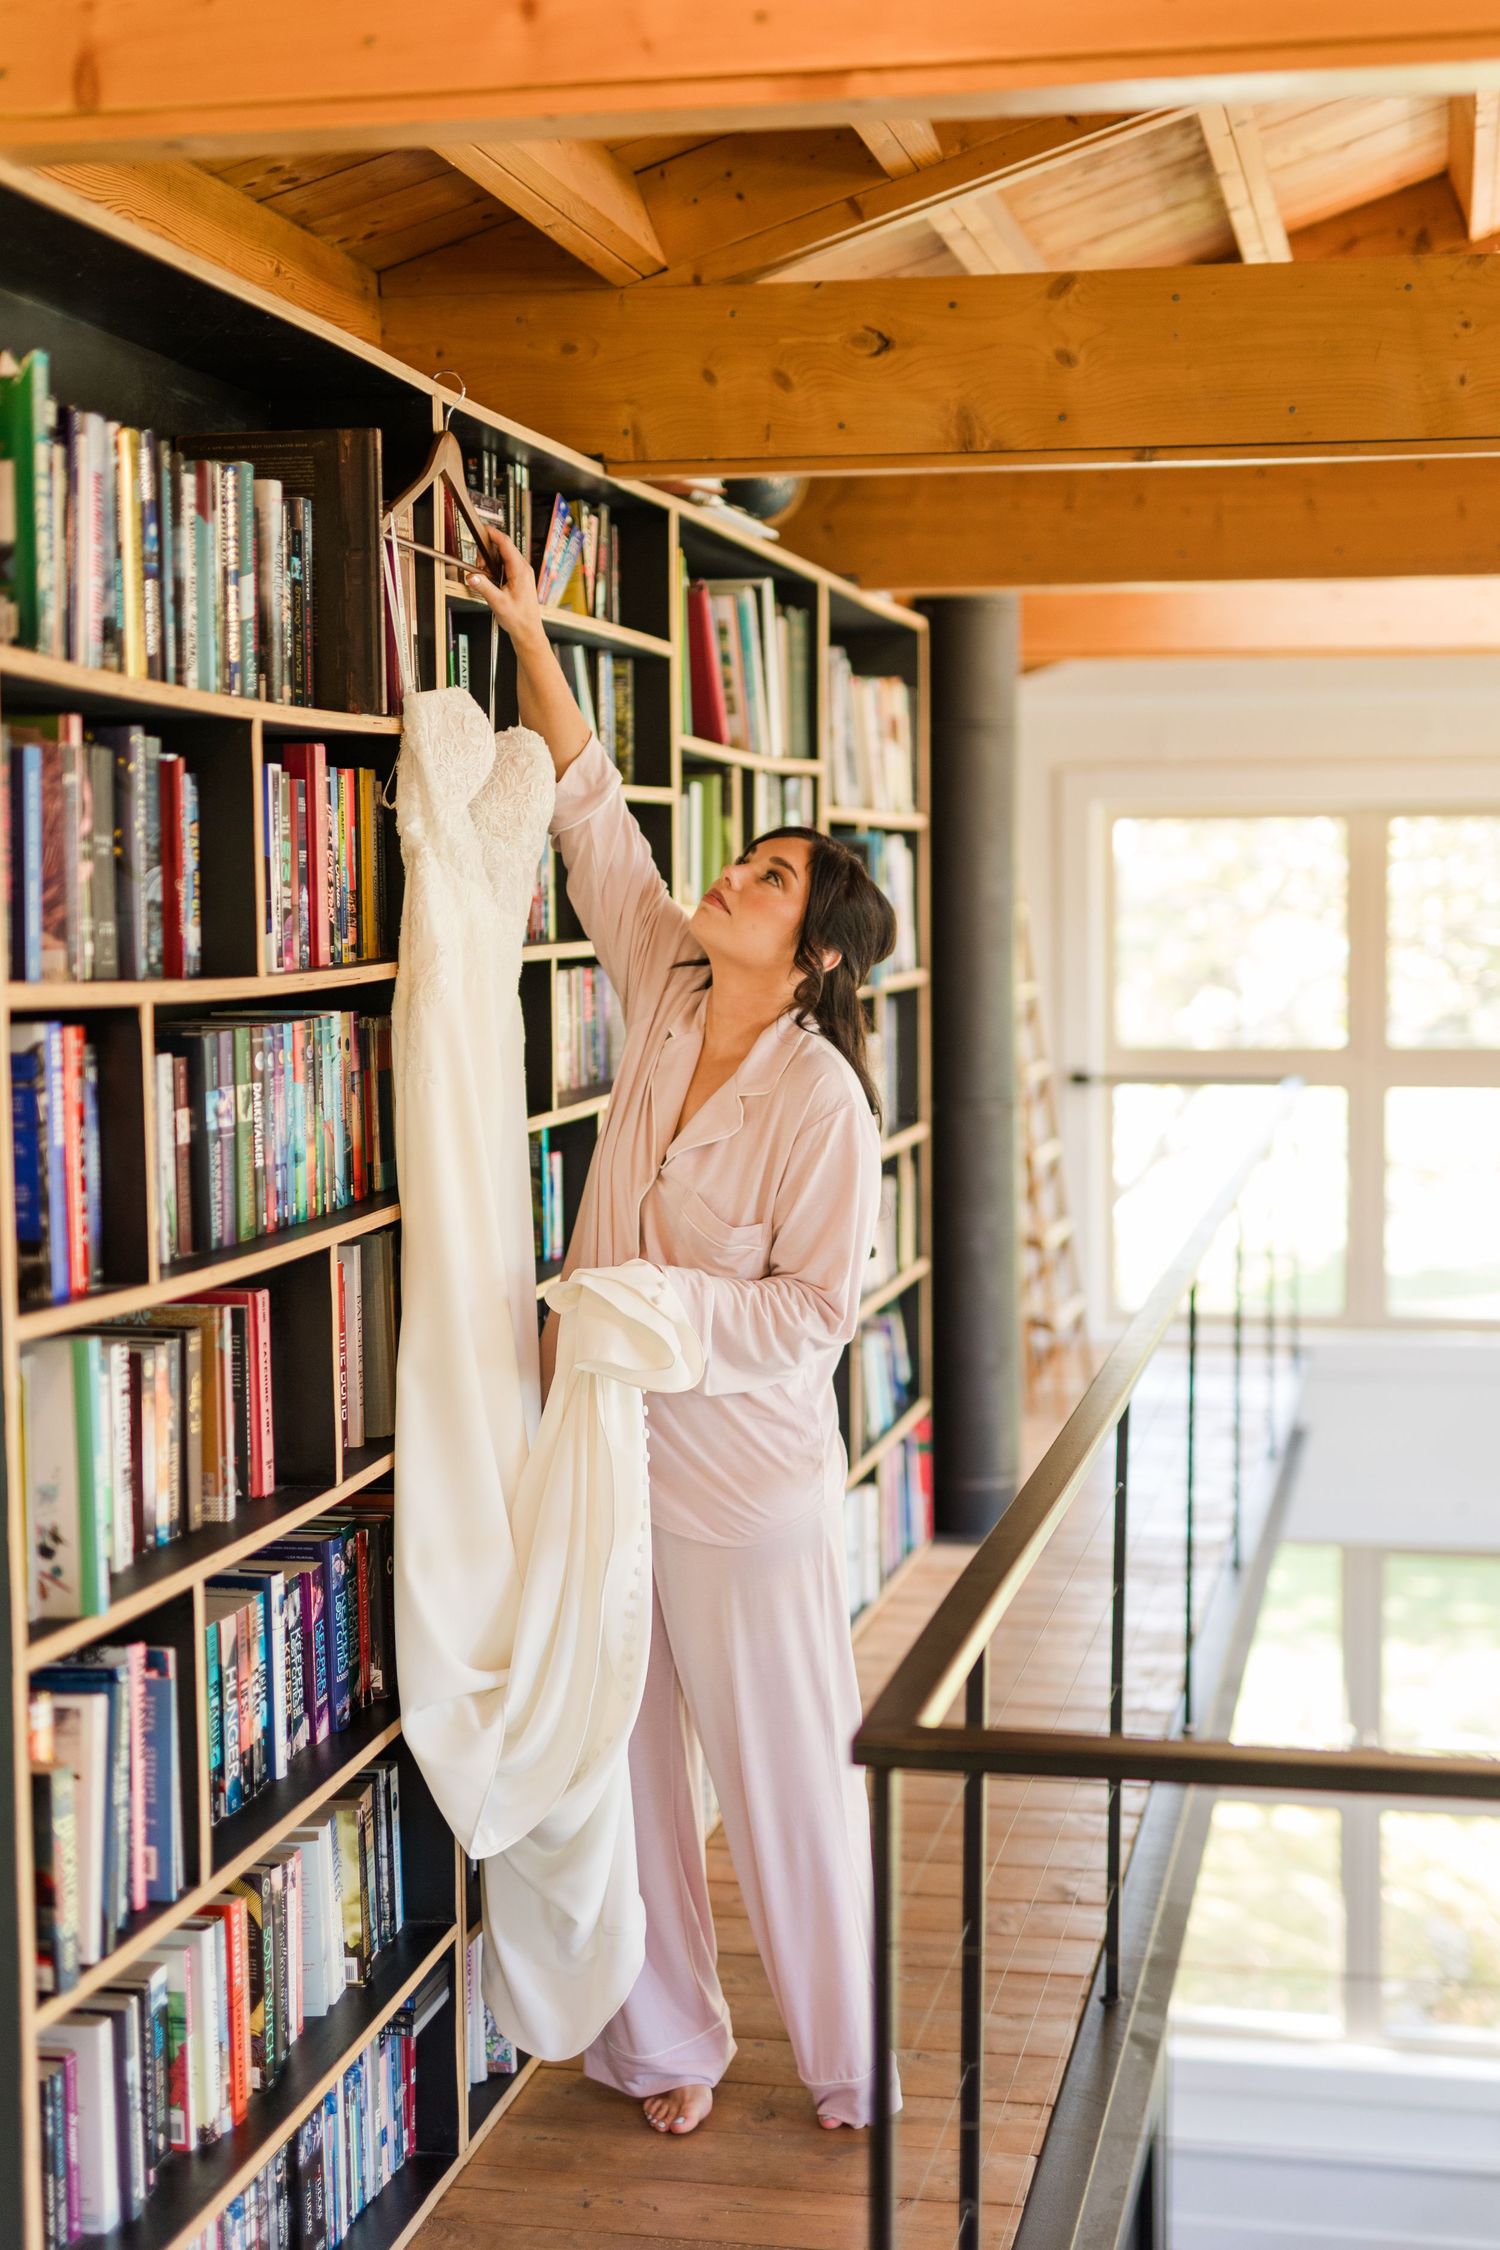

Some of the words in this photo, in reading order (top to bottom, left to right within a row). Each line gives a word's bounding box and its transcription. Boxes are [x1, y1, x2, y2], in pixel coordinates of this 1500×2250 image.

[327, 848, 336, 882] LOVE
[328, 885, 337, 925] STORY
[252, 1082, 264, 1169] DARKSTALKER
[339, 1331, 347, 1367] THE
[360, 1556, 368, 1593] QUEEN
[335, 1593, 344, 1628] LOST
[295, 1627, 305, 1698] KEEPER
[316, 1619, 327, 1691] KEEPER
[337, 1630, 347, 1676] CITIES
[239, 1678, 249, 1716] LIES
[284, 1641, 292, 1715] KEEPER
[225, 1665, 240, 1782] HUNGER
[262, 1926, 273, 1971] SON
[264, 1992, 276, 2063] WITCH
